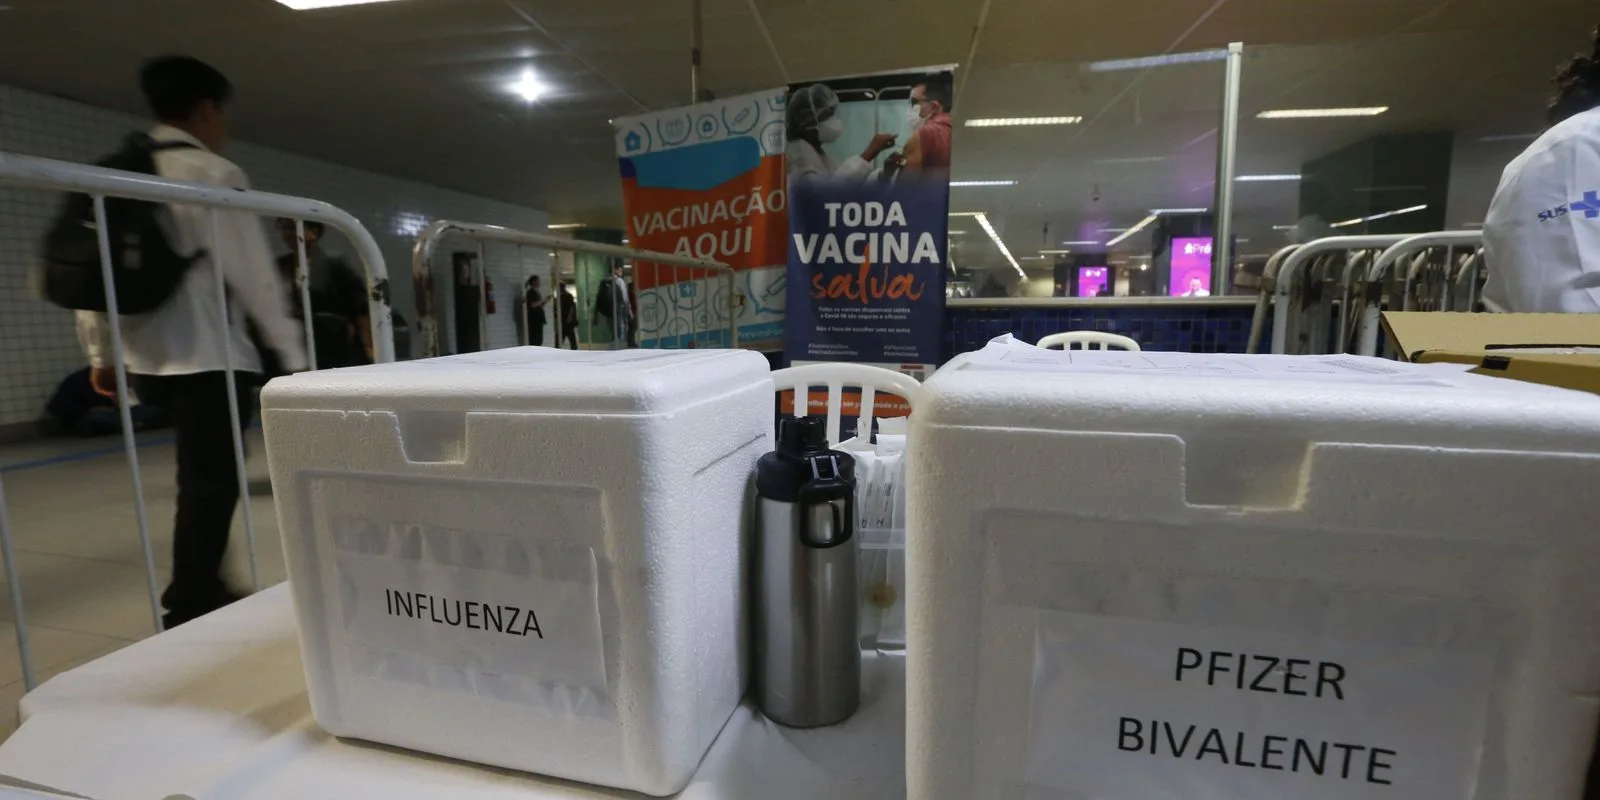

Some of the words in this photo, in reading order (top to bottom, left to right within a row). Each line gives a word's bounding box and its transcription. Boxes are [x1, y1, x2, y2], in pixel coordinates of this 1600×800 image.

[632, 186, 786, 237] VACINAÇÃO
[824, 201, 907, 228] TODA
[1537, 203, 1568, 222] SUS
[673, 226, 752, 263] AQUI
[793, 232, 940, 264] VACINA
[809, 243, 927, 305] salva
[386, 588, 543, 639] INFLUENZA
[1175, 647, 1346, 700] PFIZER
[1118, 717, 1397, 785] BIVALENTE
